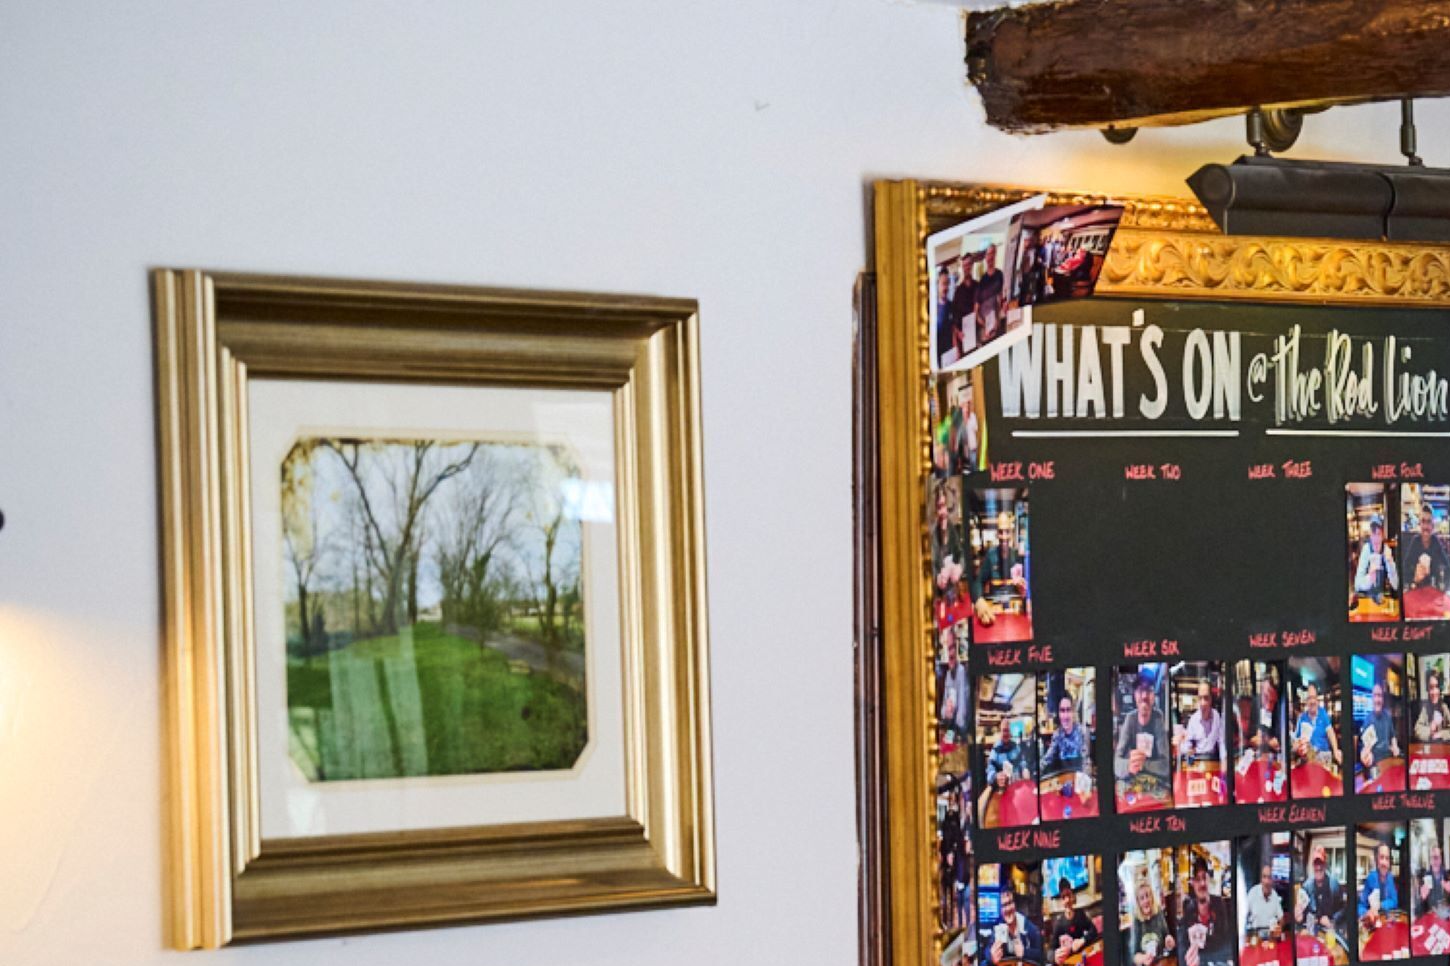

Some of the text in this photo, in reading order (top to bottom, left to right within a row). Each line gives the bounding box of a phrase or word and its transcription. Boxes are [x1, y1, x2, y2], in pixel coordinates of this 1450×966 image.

[998, 308, 1168, 420] WHAT'S
[1182, 328, 1241, 421] ON
[1324, 328, 1378, 425] Red
[1384, 334, 1449, 424] Lion
[990, 461, 1055, 482] WEEK ONE
[1125, 463, 1181, 480] WEEK TWO
[1248, 459, 1312, 480] WEEK THREE
[1372, 461, 1424, 480] WEEK FOUR
[1249, 629, 1316, 648] WEEK SEVEN
[1371, 625, 1434, 642] WEEK EIGHT
[987, 645, 1054, 666] WEEK FIVE
[1124, 639, 1180, 658] WEEK SIX
[1372, 792, 1436, 811] WEEK TWELVE
[1258, 801, 1327, 824] WEEK ELEVEN
[1130, 814, 1187, 834] WEEK TEN
[997, 829, 1061, 851] WEEK NINE
